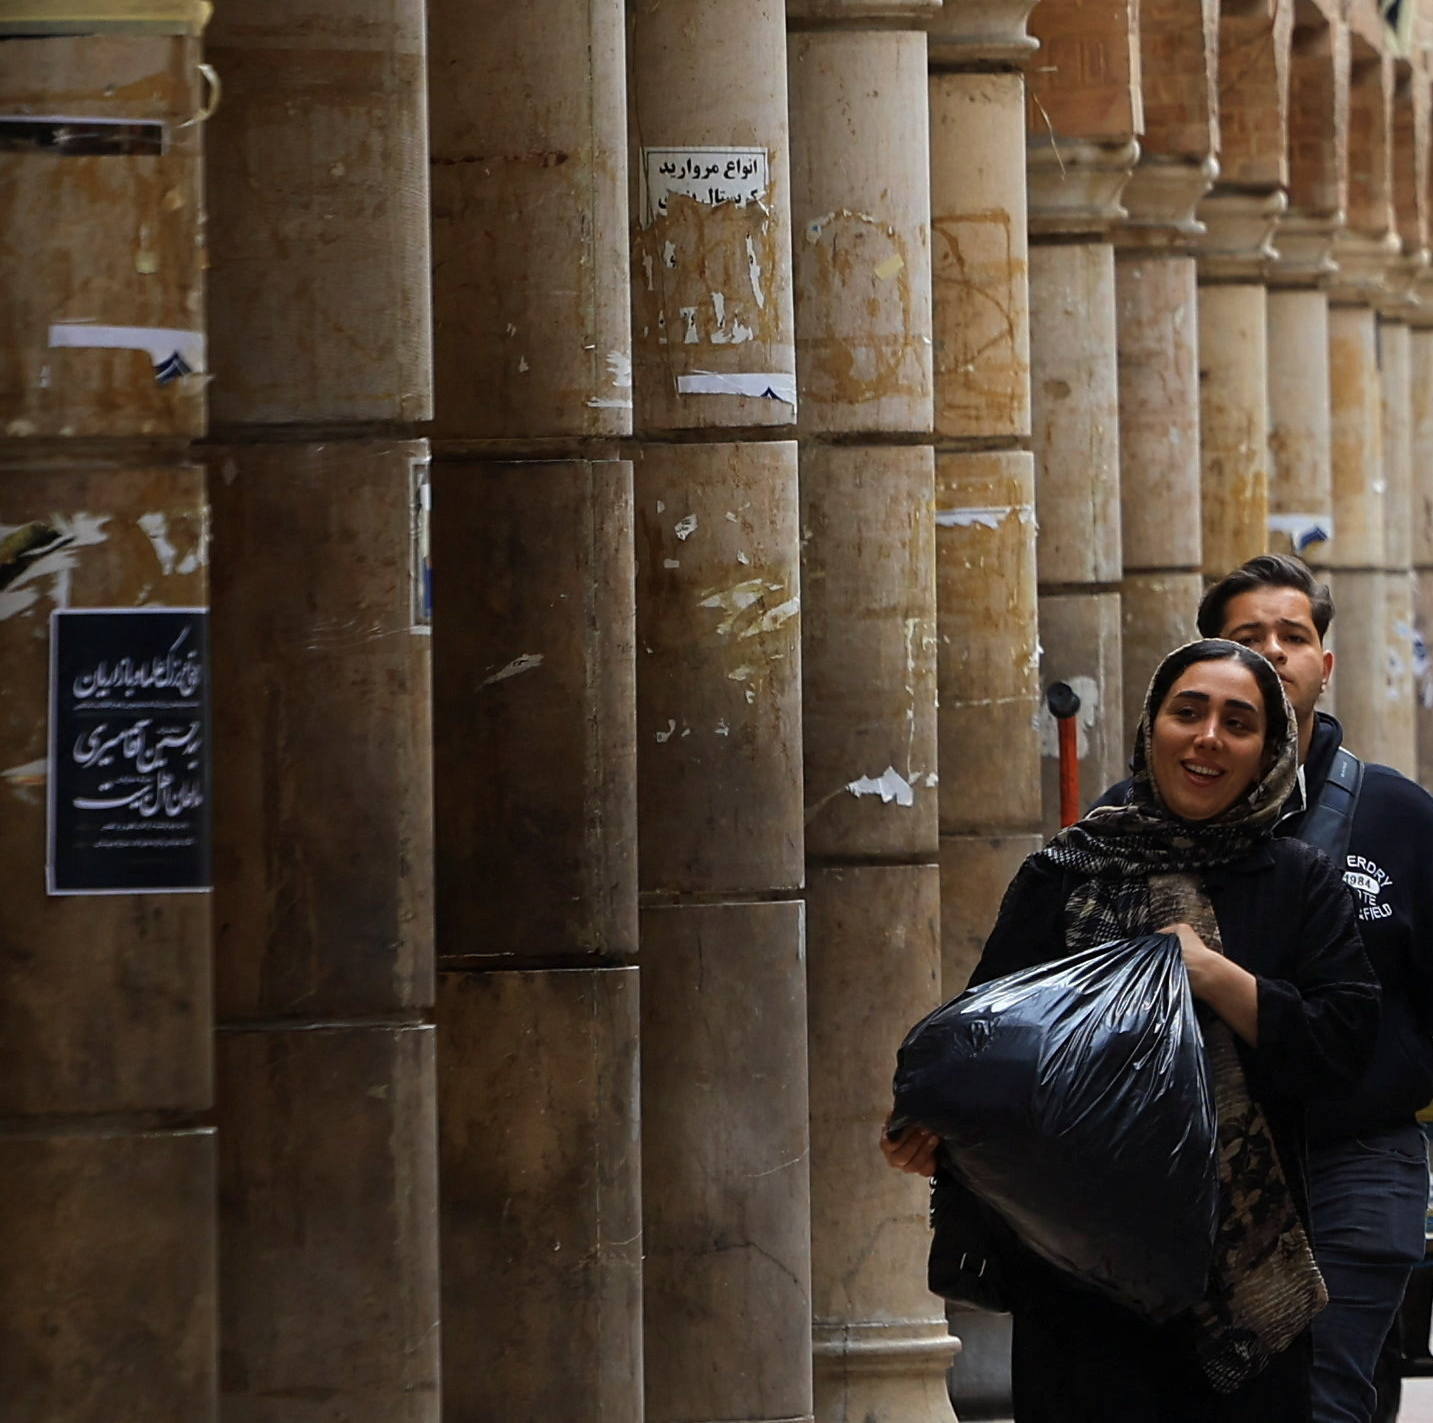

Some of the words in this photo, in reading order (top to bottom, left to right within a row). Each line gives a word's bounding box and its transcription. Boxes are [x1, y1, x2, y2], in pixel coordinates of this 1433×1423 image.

[659, 157, 720, 180] مروارید
[724, 157, 758, 180] انواع
[72, 655, 136, 699] بازاریان
[1346, 854, 1394, 888] ERDRY
